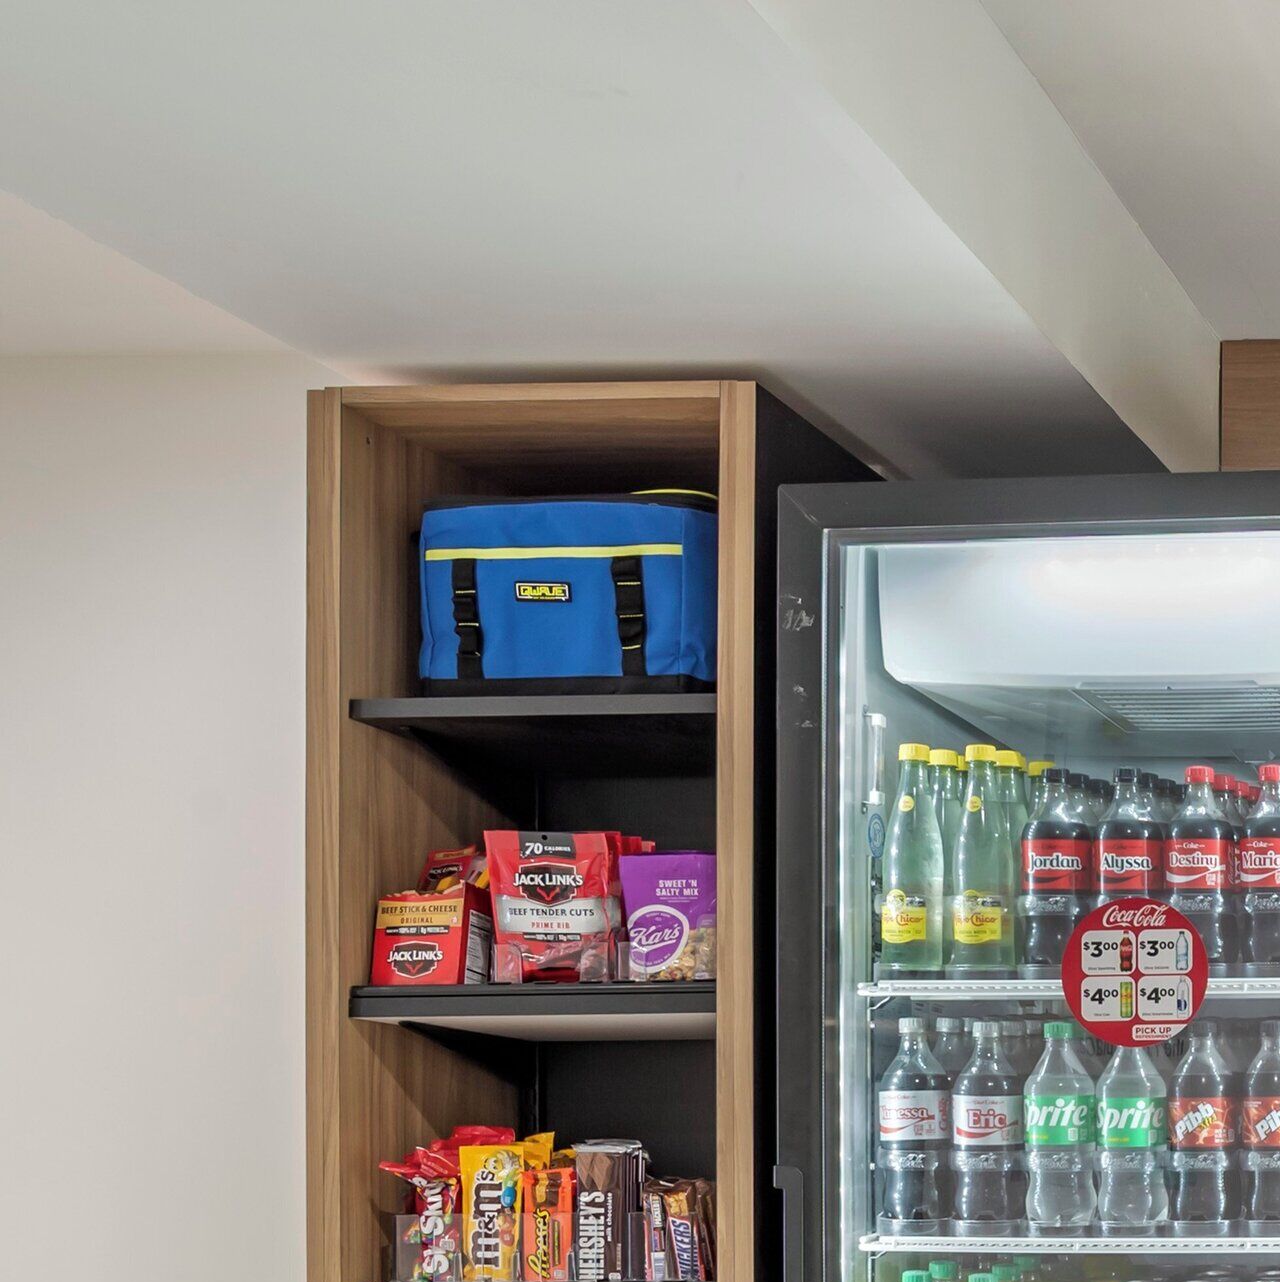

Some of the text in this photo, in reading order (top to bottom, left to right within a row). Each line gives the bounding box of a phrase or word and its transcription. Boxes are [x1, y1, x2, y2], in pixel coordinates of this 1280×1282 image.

[525, 842, 543, 855] 70
[1028, 851, 1082, 872] Jordan
[1101, 851, 1152, 872] Alyssa
[1169, 851, 1219, 869] Destiny
[513, 872, 545, 887] JACK
[658, 879, 686, 887] SWEET
[655, 888, 699, 896] SALTY MIX
[381, 906, 398, 915] BEEF
[400, 905, 420, 913] STICK
[428, 904, 458, 913] CHEESE
[508, 907, 595, 917] BEEF TENDER CUTS
[1102, 904, 1169, 928] Coca-Cola
[896, 913, 923, 926] Chico
[970, 912, 998, 926] Chico
[629, 923, 680, 945] Kar's
[387, 950, 413, 962] JACK
[967, 1109, 1007, 1129] Eric
[1097, 1100, 1164, 1130] Sprite
[1174, 1102, 1217, 1142] Pibb
[527, 1207, 551, 1280] Reese's
[577, 1191, 606, 1282] HERSHEY'S
